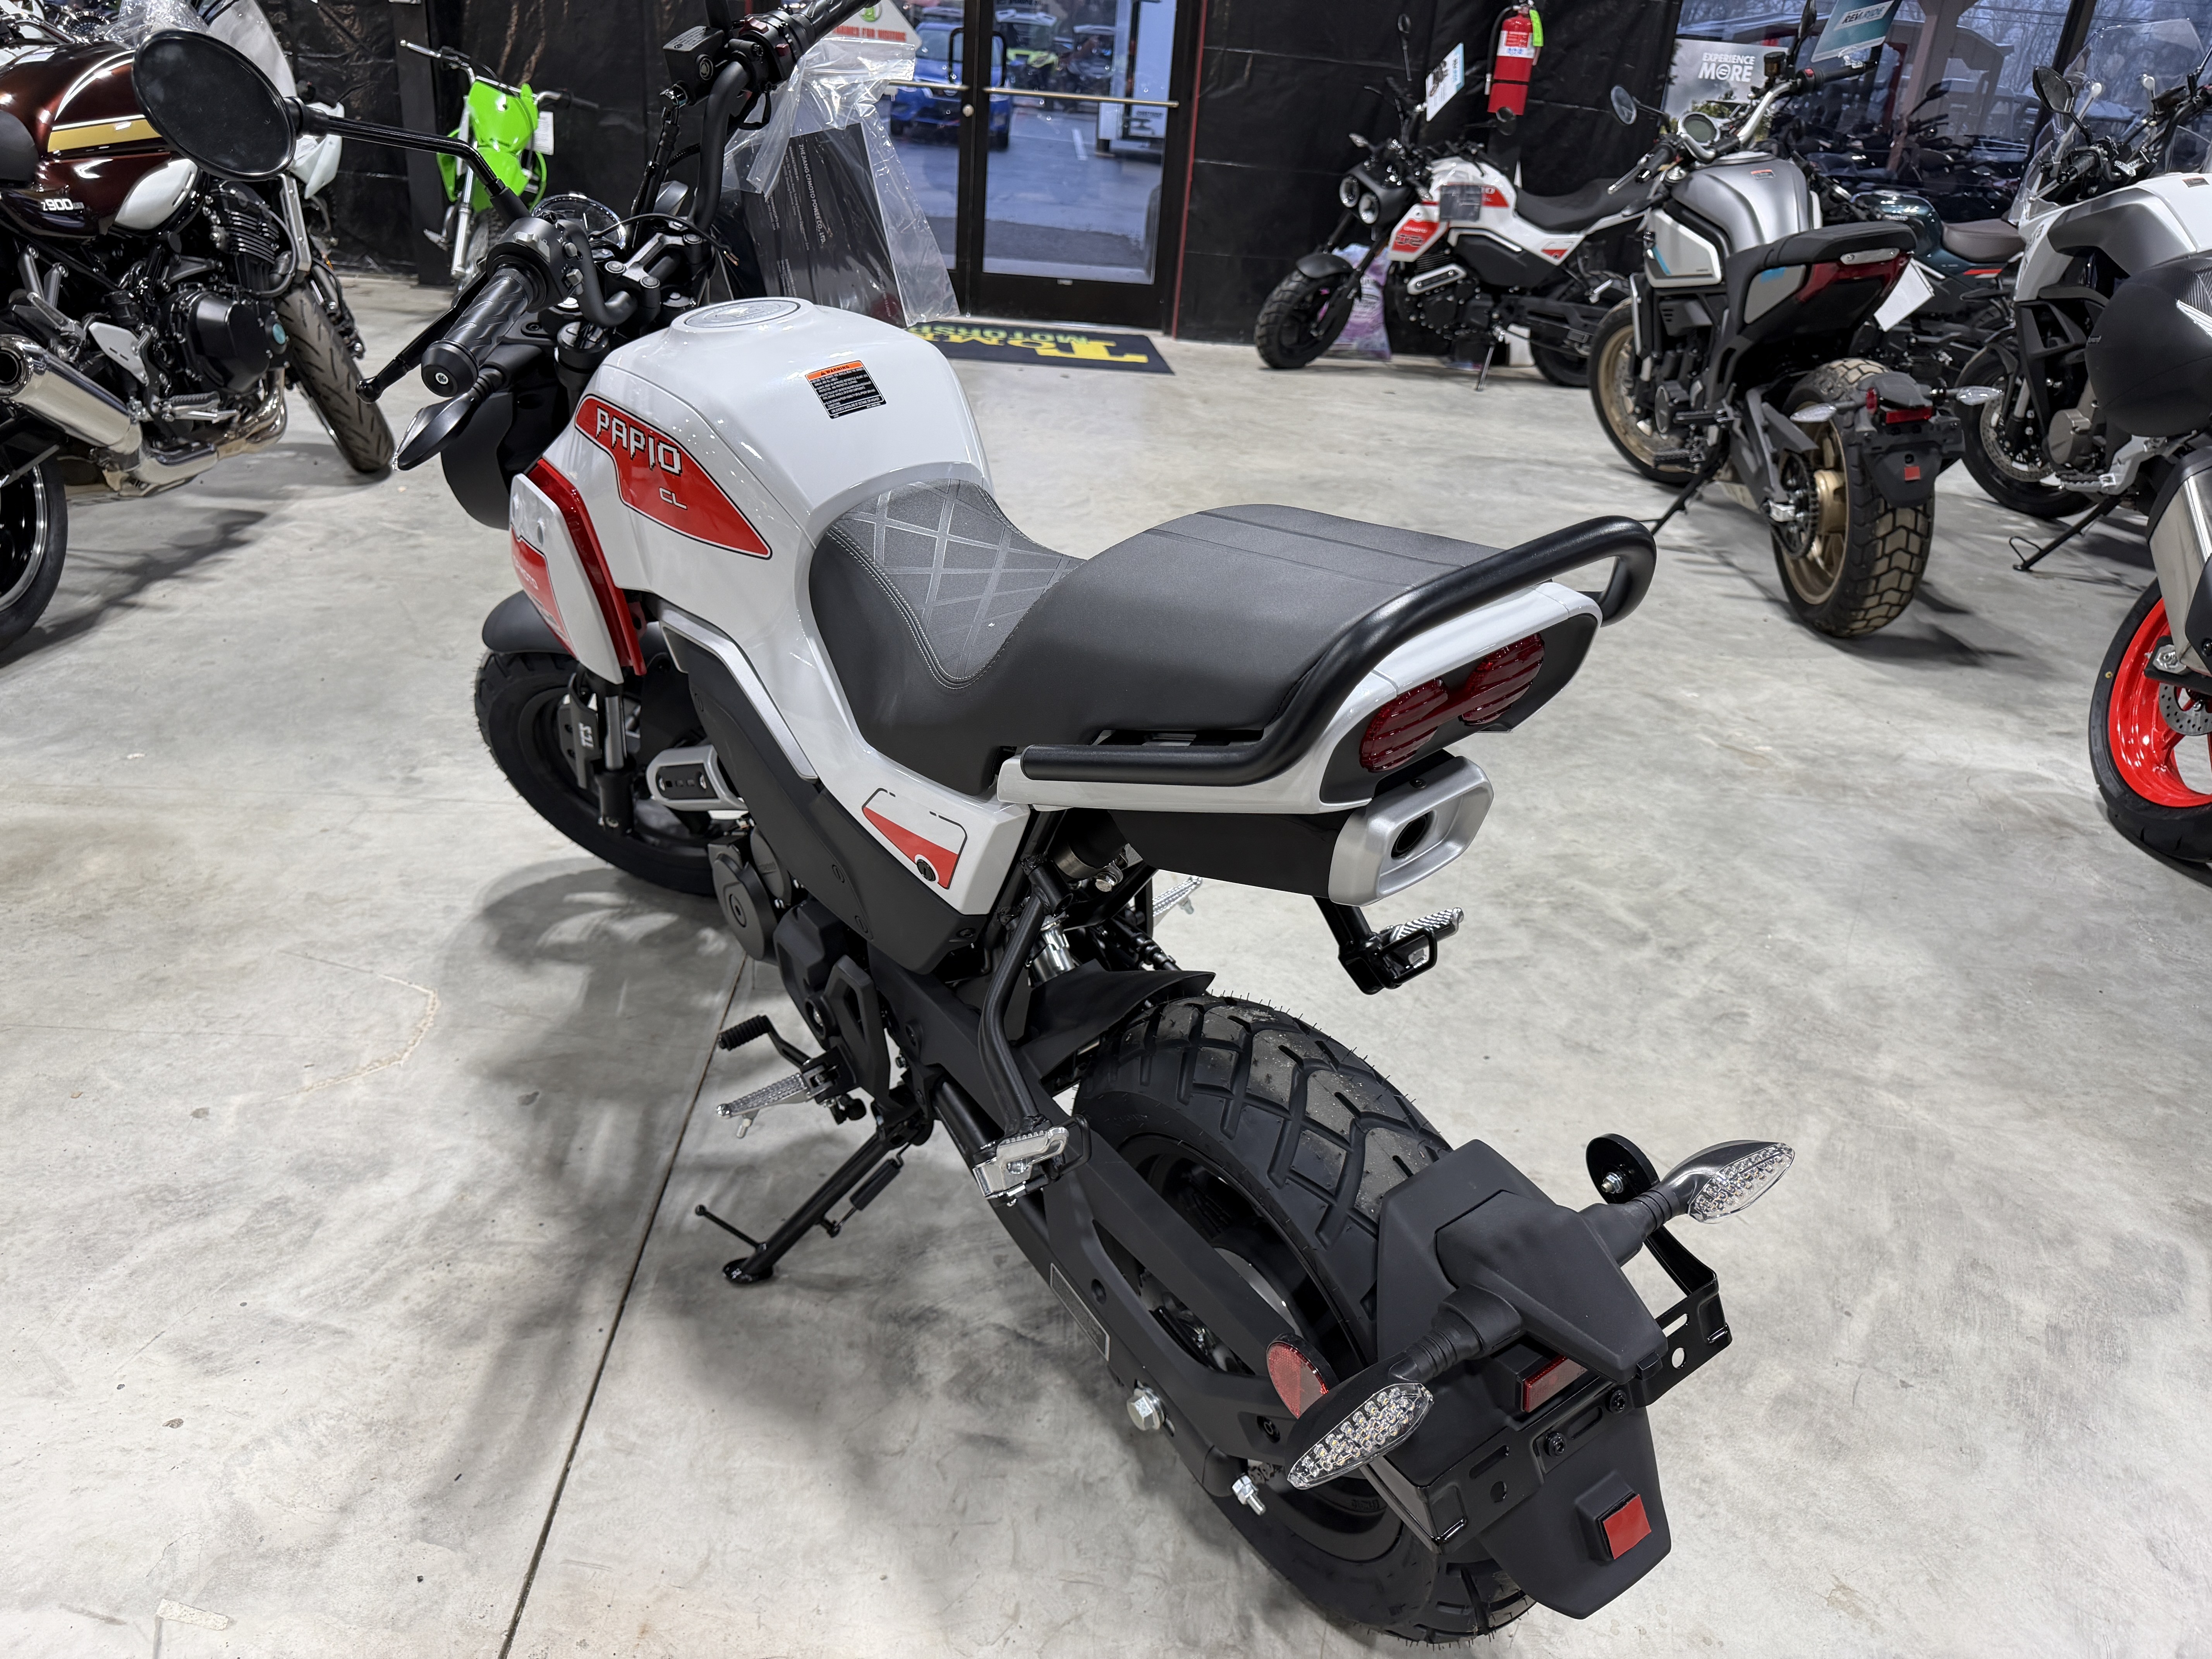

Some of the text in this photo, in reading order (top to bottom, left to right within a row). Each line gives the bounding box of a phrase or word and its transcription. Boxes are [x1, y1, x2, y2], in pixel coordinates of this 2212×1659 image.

[1702, 52, 1755, 65] EXPERIENCE
[1698, 62, 1753, 82] MORE
[799, 144, 810, 173] ZHEJIANG
[805, 174, 816, 198] CFMOTO
[812, 199, 821, 220] POWER
[826, 365, 850, 374] WARNING
[596, 405, 683, 477] PAPIO
[659, 486, 688, 510] CL
